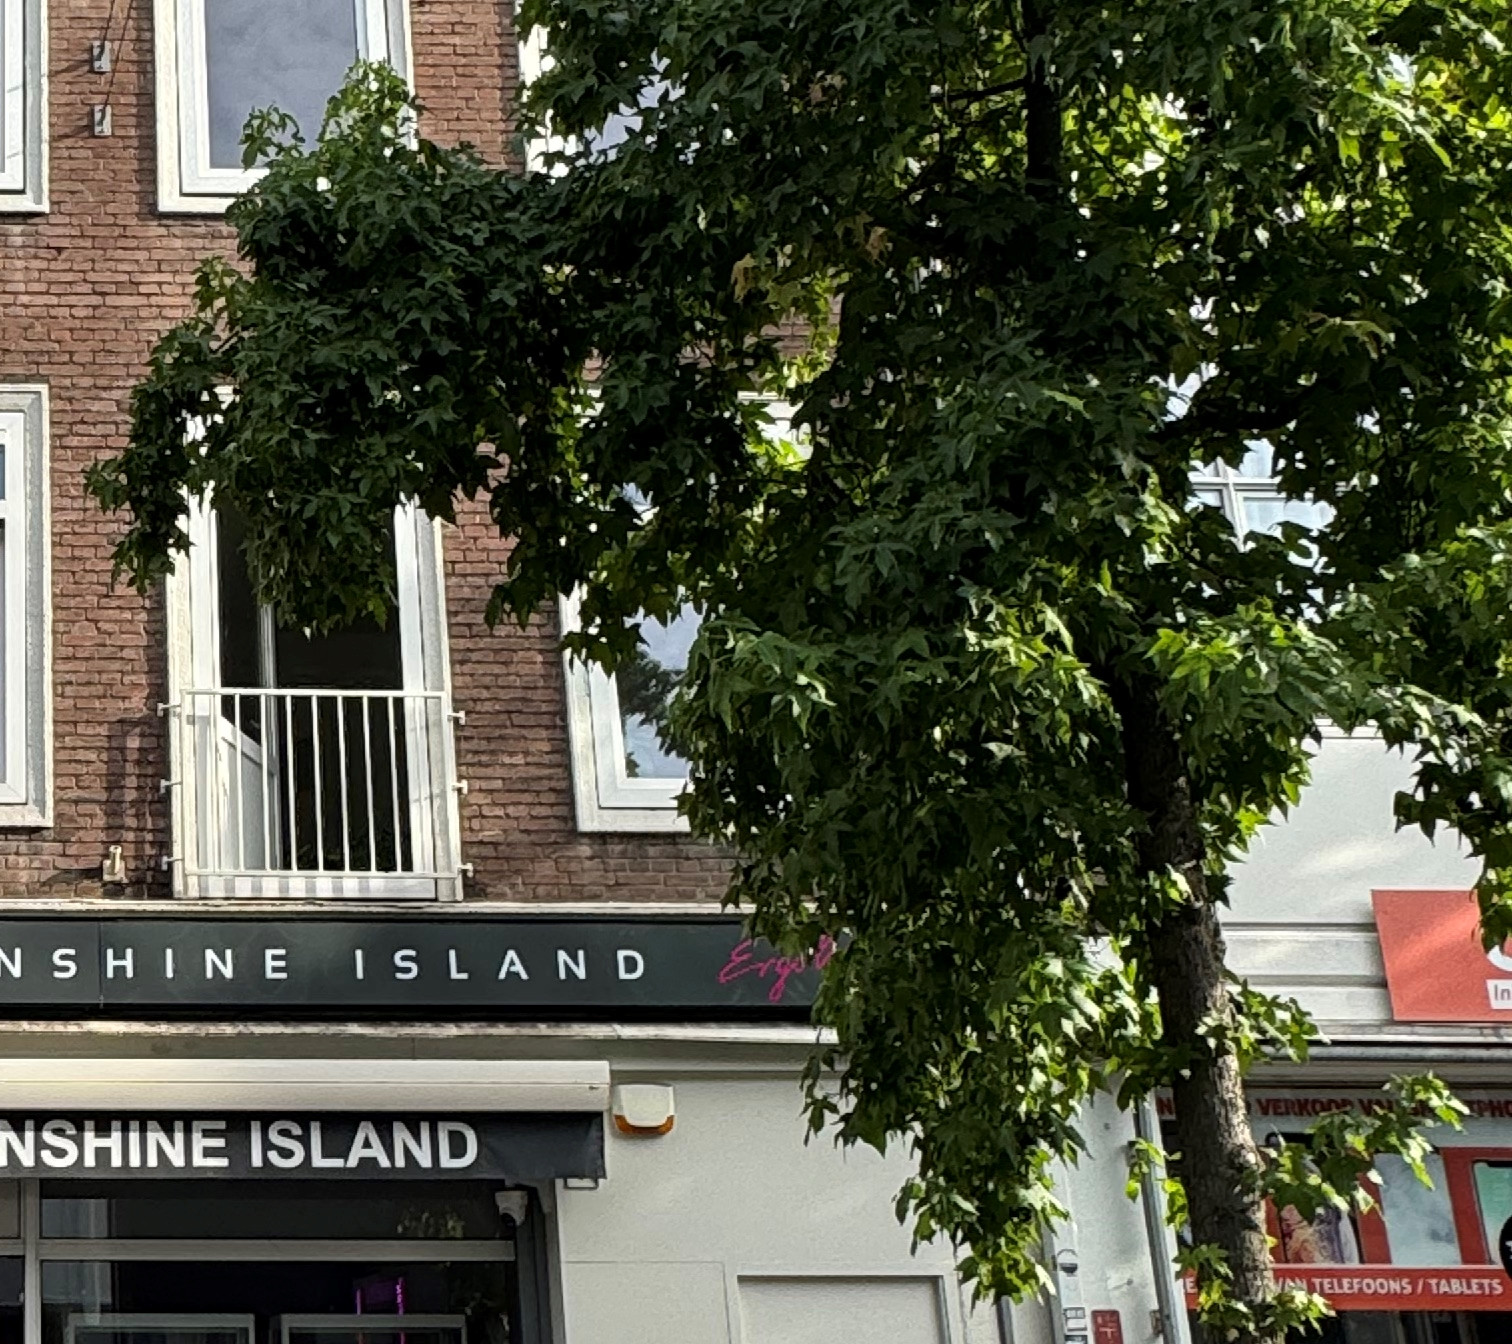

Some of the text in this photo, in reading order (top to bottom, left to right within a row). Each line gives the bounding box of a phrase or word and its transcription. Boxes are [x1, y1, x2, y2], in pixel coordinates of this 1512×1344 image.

[355, 948, 647, 982] ISLAND
[249, 1119, 479, 1171] ISLAND
[1311, 1276, 1413, 1296] TELEFOONS
[1427, 1277, 1504, 1296] TABLETS
